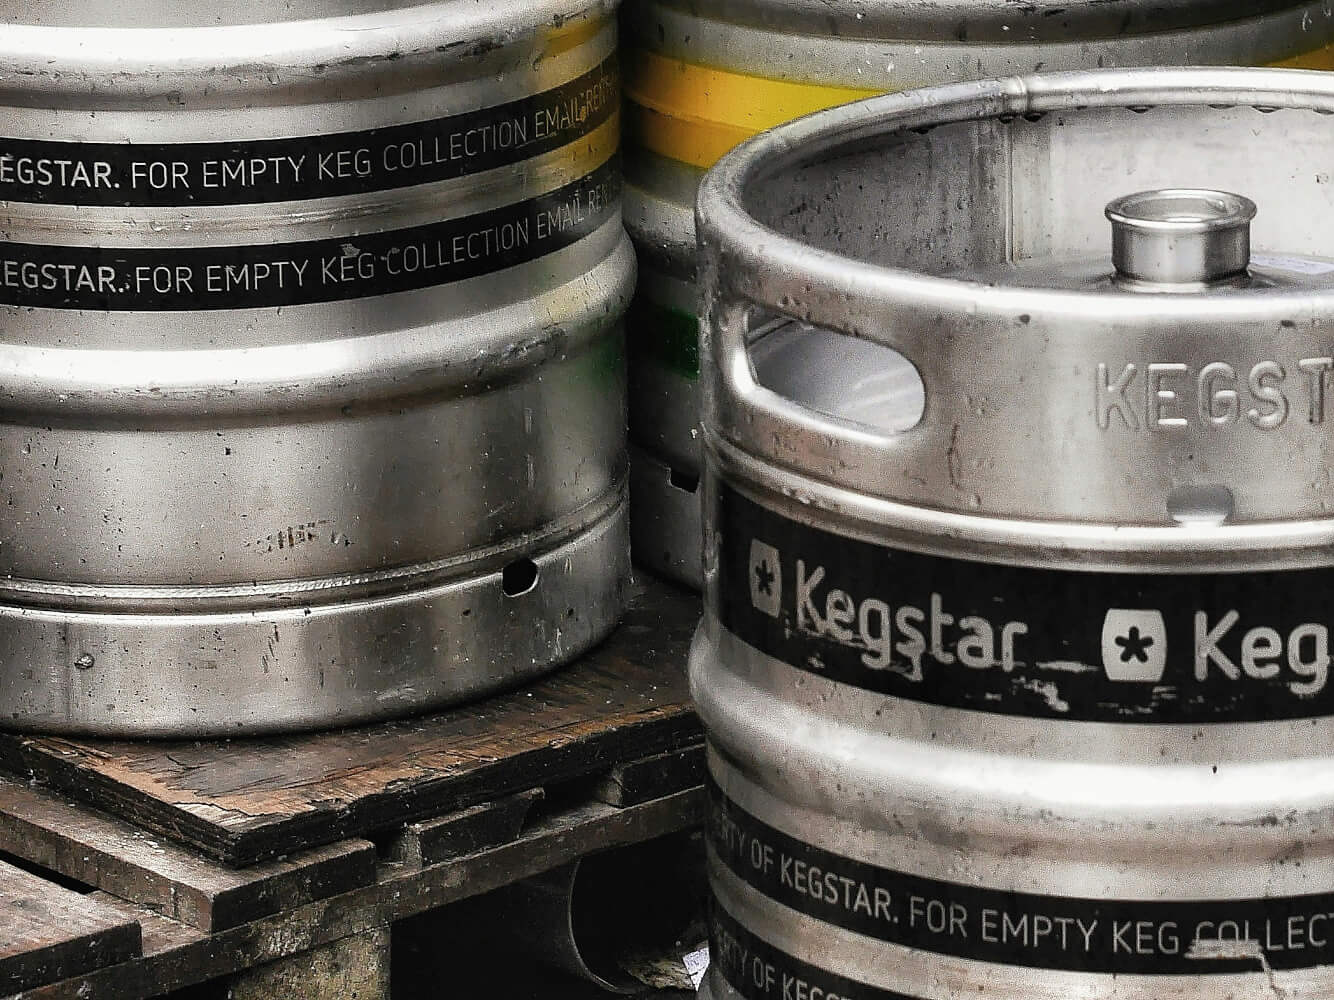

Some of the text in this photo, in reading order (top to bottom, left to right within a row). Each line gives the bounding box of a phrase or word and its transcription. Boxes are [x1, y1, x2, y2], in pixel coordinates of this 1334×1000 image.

[131, 161, 189, 190] FOR
[202, 154, 306, 189] EMPTY
[318, 148, 371, 181] KEG
[383, 115, 527, 172] COLLECTION
[534, 99, 583, 139] EMAIL
[0, 259, 124, 293] EGSTAR.
[136, 266, 193, 294] FOR
[206, 258, 308, 293] EMPTY
[321, 252, 375, 285] KEG
[385, 217, 529, 275] COLLECTION
[536, 194, 583, 240] EMAIL
[796, 559, 1028, 672] Kegstar
[750, 838, 774, 873] OF
[780, 853, 898, 924] KEGSTAR.
[910, 895, 968, 939] FOR
[981, 908, 1098, 952] EMPTY
[1112, 920, 1180, 955] KEG
[752, 955, 776, 994] OF
